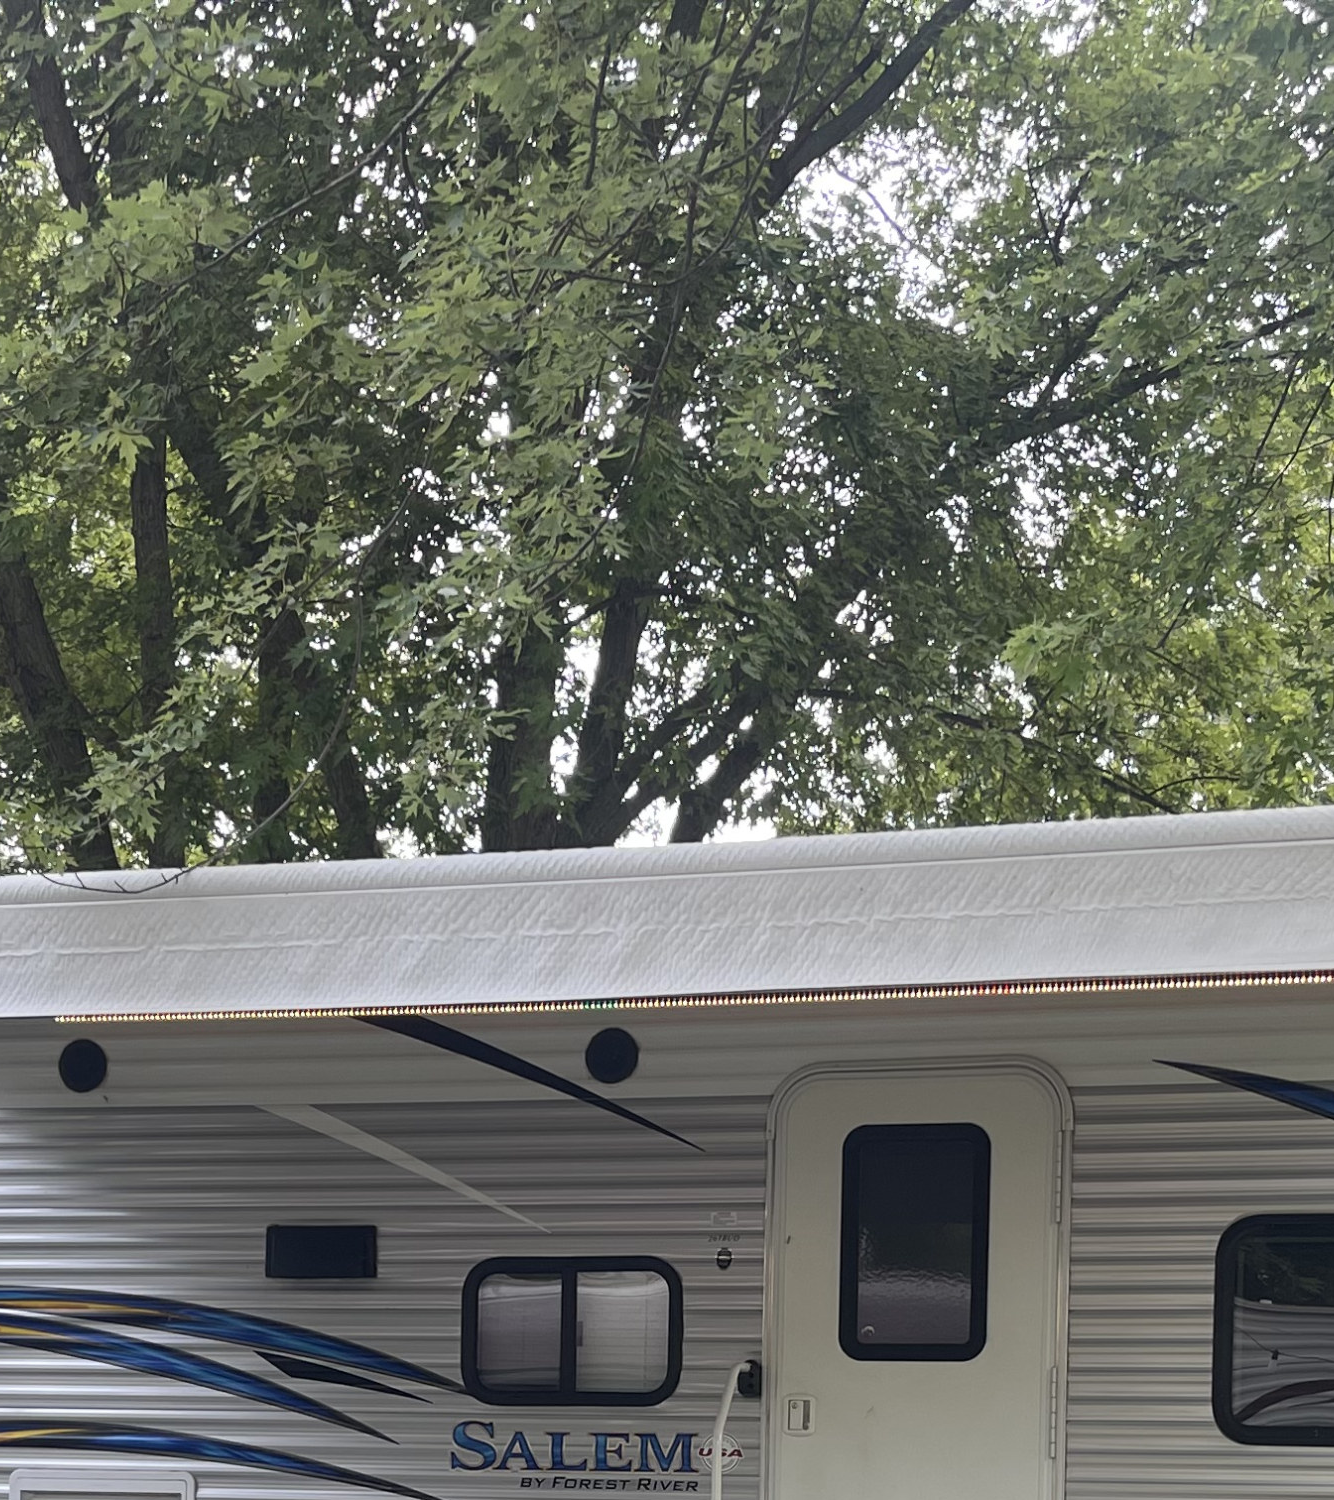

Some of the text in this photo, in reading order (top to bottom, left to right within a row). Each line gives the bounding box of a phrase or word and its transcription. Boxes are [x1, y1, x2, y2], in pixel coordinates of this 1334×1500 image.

[451, 1420, 699, 1472] SALEM
[520, 1476, 699, 1492] BY FOREST RIVER
